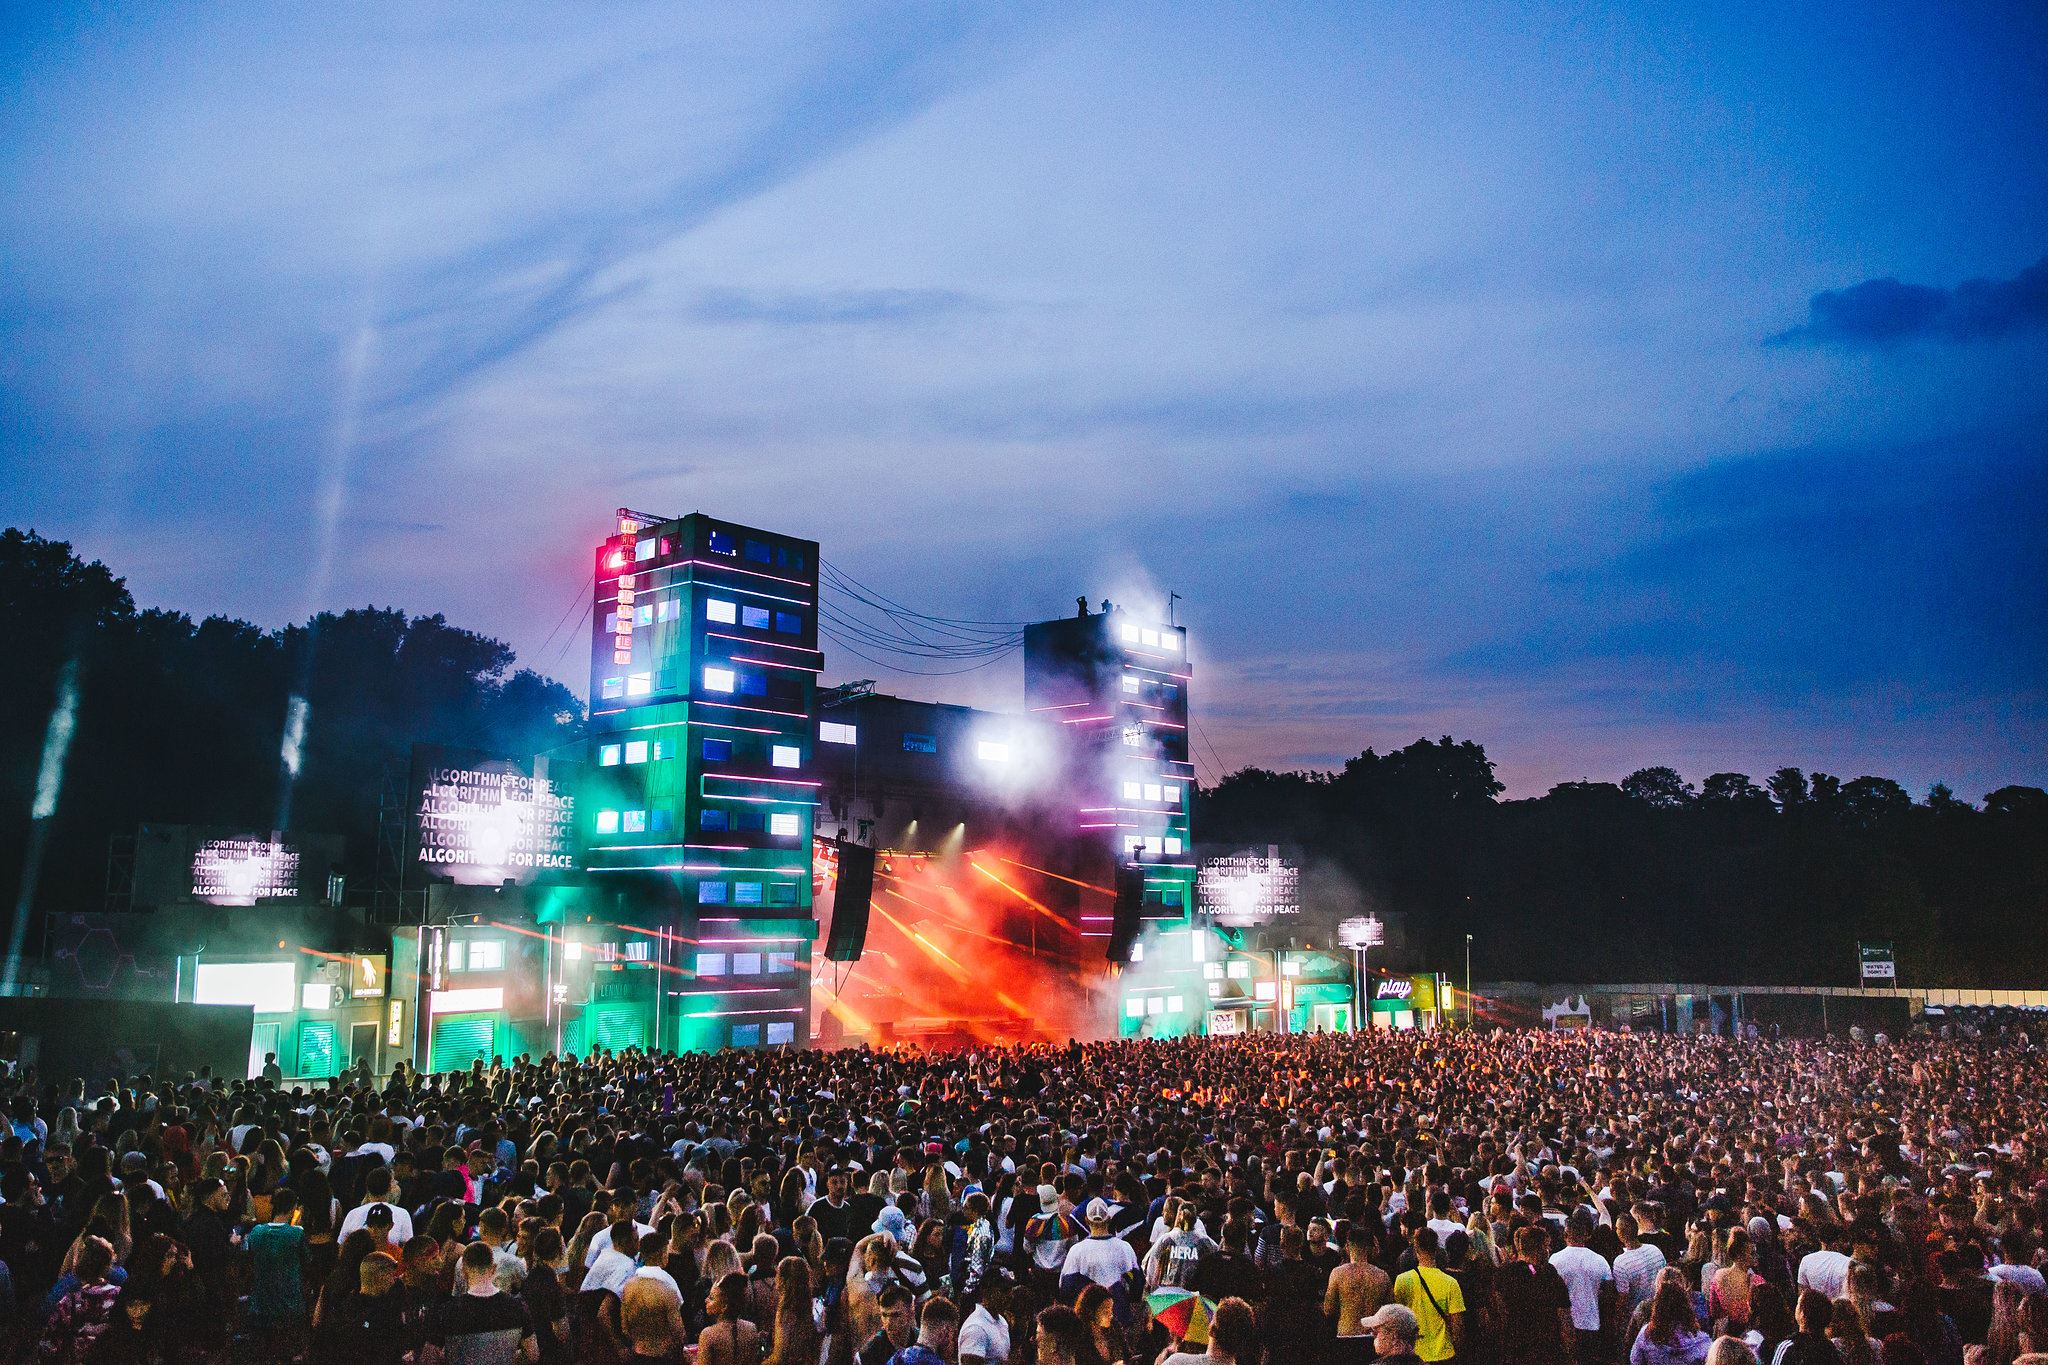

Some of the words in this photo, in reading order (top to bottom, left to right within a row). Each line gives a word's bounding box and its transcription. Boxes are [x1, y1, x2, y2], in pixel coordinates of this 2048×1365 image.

[539, 794, 575, 809] PEACE
[538, 809, 574, 823] PEACE
[537, 824, 573, 838] PEACE
[508, 852, 533, 867] FOR
[536, 853, 573, 868] PEACE
[273, 861, 300, 870] PEACE
[272, 870, 299, 879] PEACE
[1272, 867, 1299, 876] PEACE
[1273, 877, 1299, 885] PEACE
[253, 887, 270, 896] FOR
[271, 887, 298, 897] PEACE
[1273, 886, 1299, 895] PEACE
[1255, 905, 1272, 914] FOR
[1274, 905, 1300, 914] PEACE
[1376, 979, 1412, 999] play
[1170, 1245, 1198, 1260] HERA
